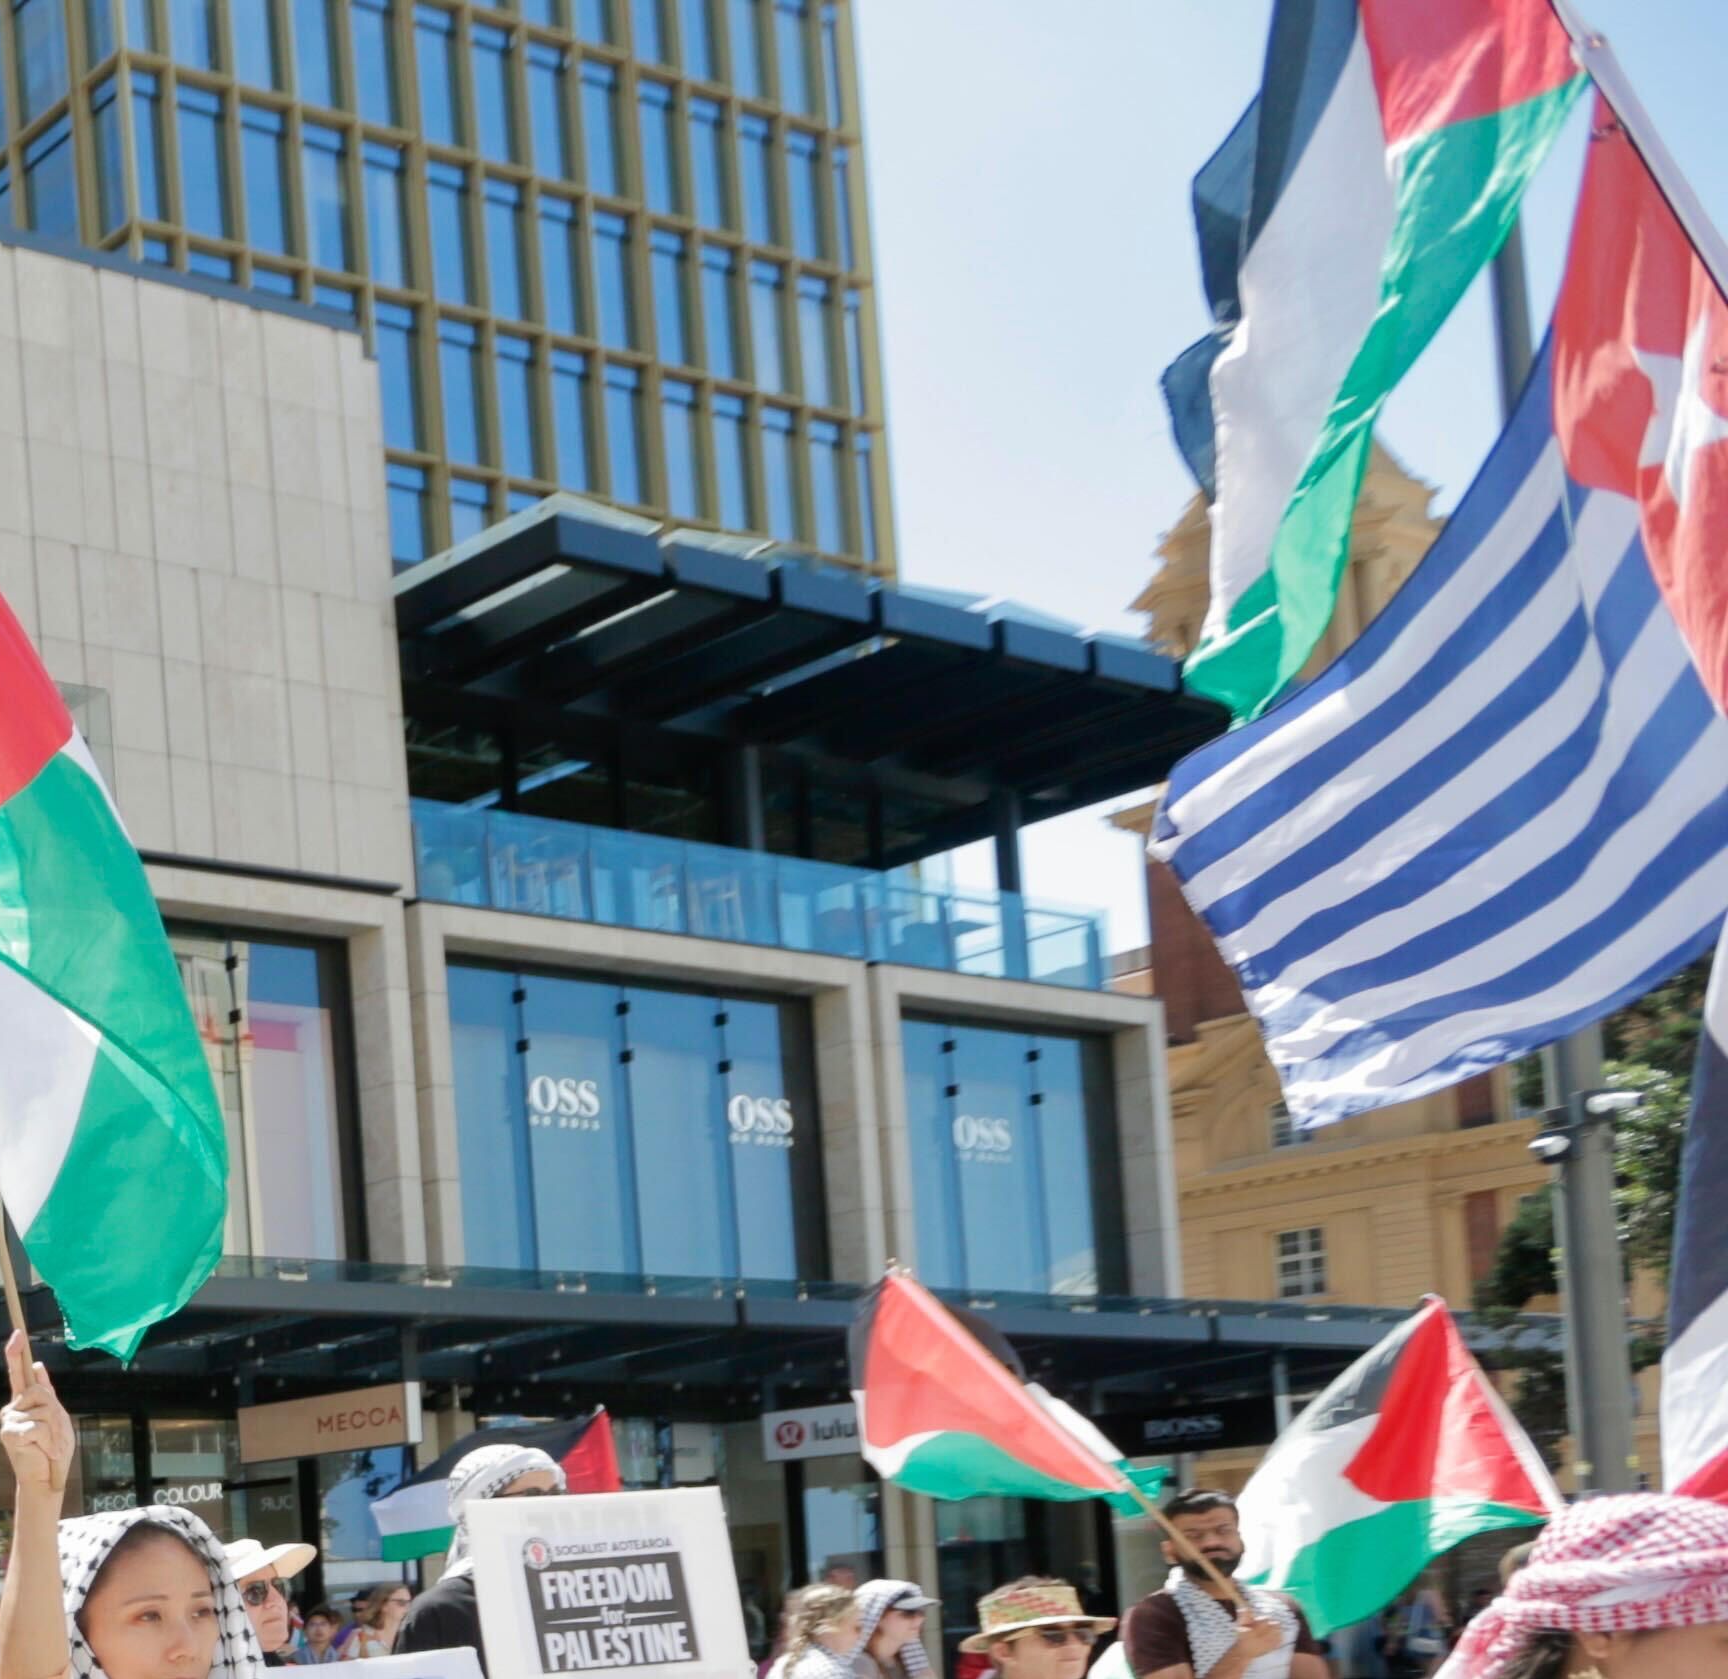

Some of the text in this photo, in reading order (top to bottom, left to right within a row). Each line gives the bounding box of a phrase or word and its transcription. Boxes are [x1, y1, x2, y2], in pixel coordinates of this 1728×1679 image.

[529, 1075, 601, 1118] OSS
[727, 1094, 794, 1134] OSS
[952, 1115, 1012, 1153] OSS
[316, 1406, 402, 1434] MECCA
[1144, 1414, 1223, 1440] BOSS
[153, 1483, 224, 1506] COLOUR
[554, 1536, 673, 1556] SOCIALIST AOTEAROA
[539, 1562, 674, 1610] FREEDOM
[544, 1621, 693, 1672] PALESTINE
